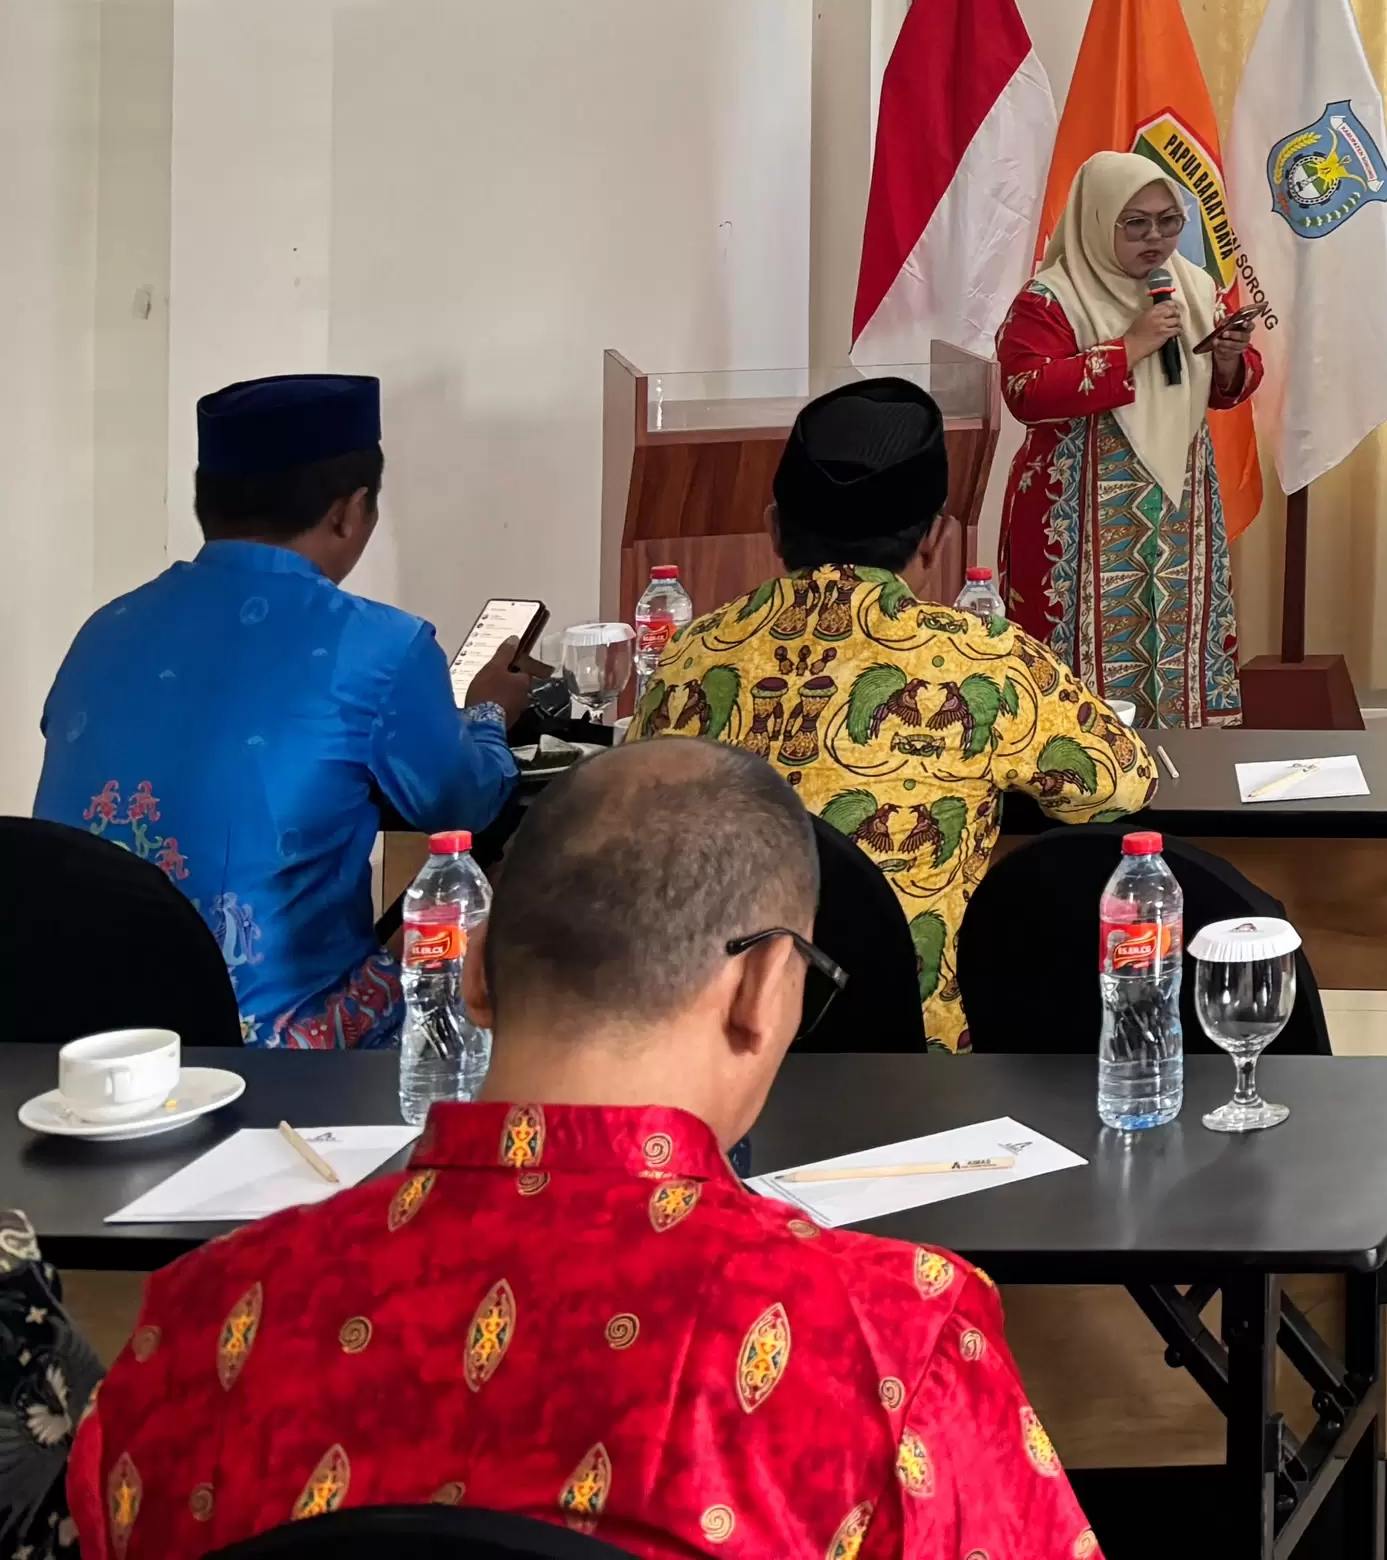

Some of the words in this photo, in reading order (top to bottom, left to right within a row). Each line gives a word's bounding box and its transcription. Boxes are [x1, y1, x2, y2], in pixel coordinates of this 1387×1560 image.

[1163, 133, 1202, 180] PAPUA
[1193, 172, 1226, 221] BARAT
[1212, 218, 1234, 261] DAYA
[1235, 253, 1279, 331] SORONG
